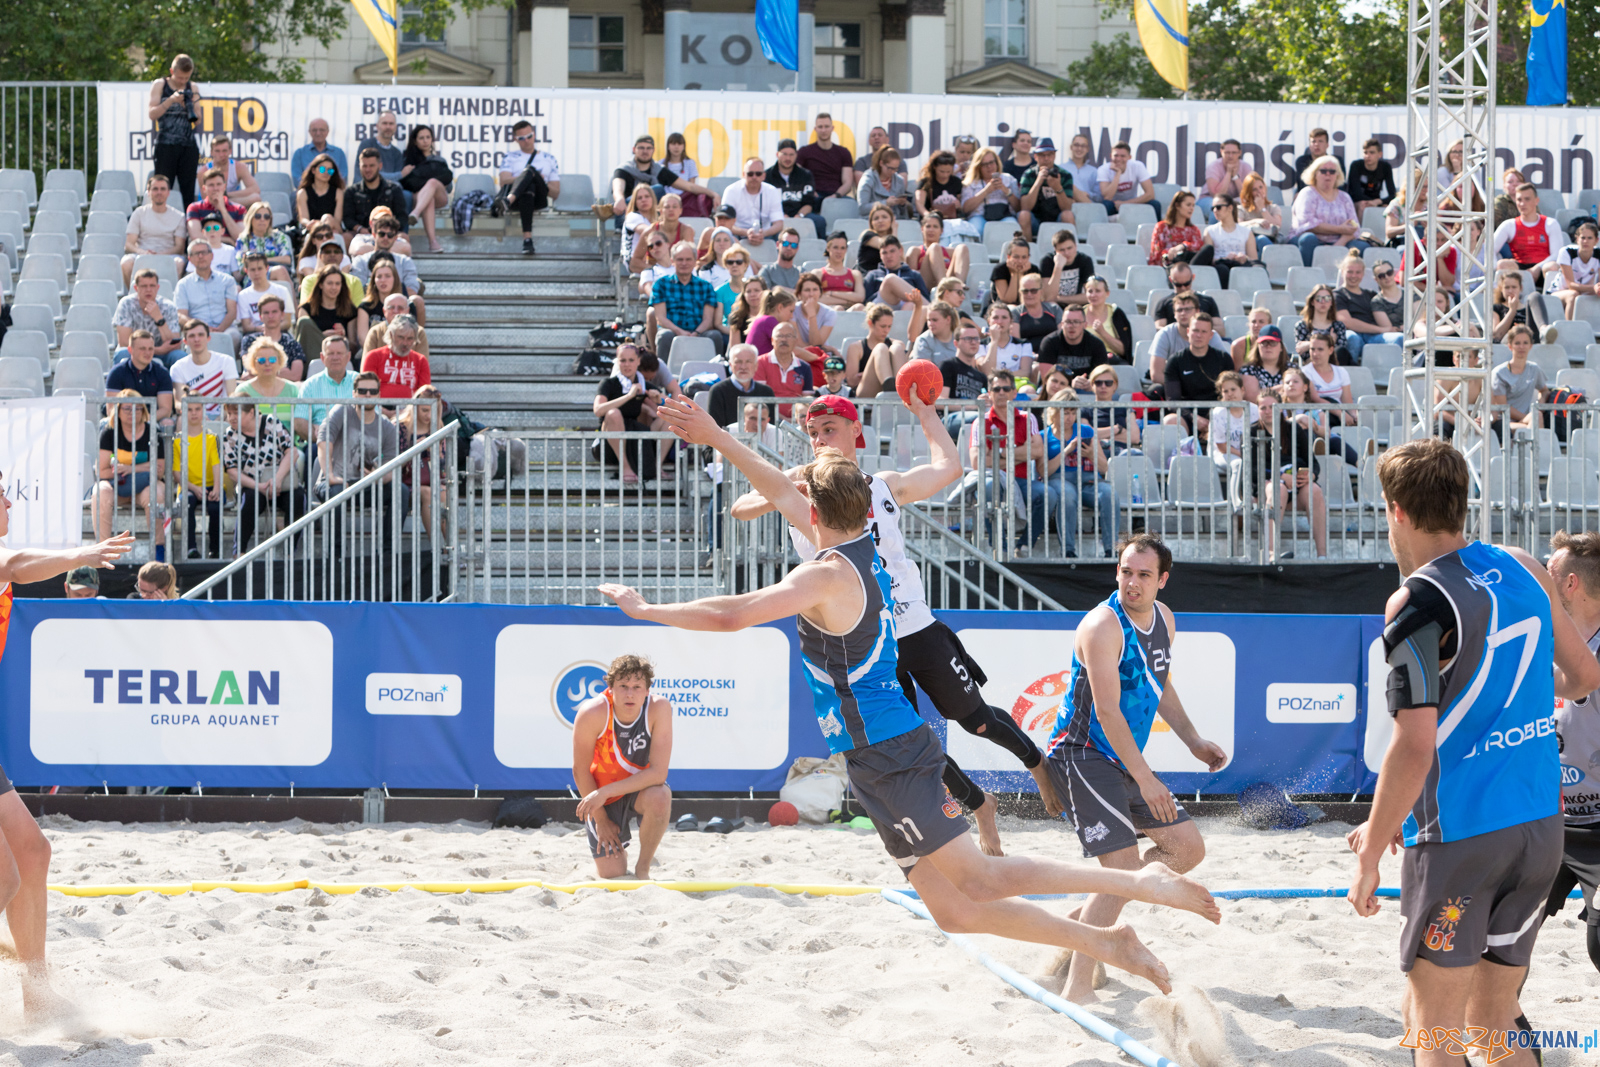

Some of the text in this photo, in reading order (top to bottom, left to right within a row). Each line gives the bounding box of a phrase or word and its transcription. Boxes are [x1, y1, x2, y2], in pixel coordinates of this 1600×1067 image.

[681, 34, 776, 66] KO
[155, 99, 265, 133] TTO
[363, 97, 544, 117] BEACH HANDBALL
[431, 124, 552, 143] VOLLEYBLL
[451, 151, 505, 169] SOCC
[950, 656, 968, 681] 5
[1486, 616, 1541, 708] 7
[84, 669, 280, 705] TERLAN
[150, 714, 280, 728] GRUPA AQUANET
[678, 704, 729, 717] NOŻNEJ
